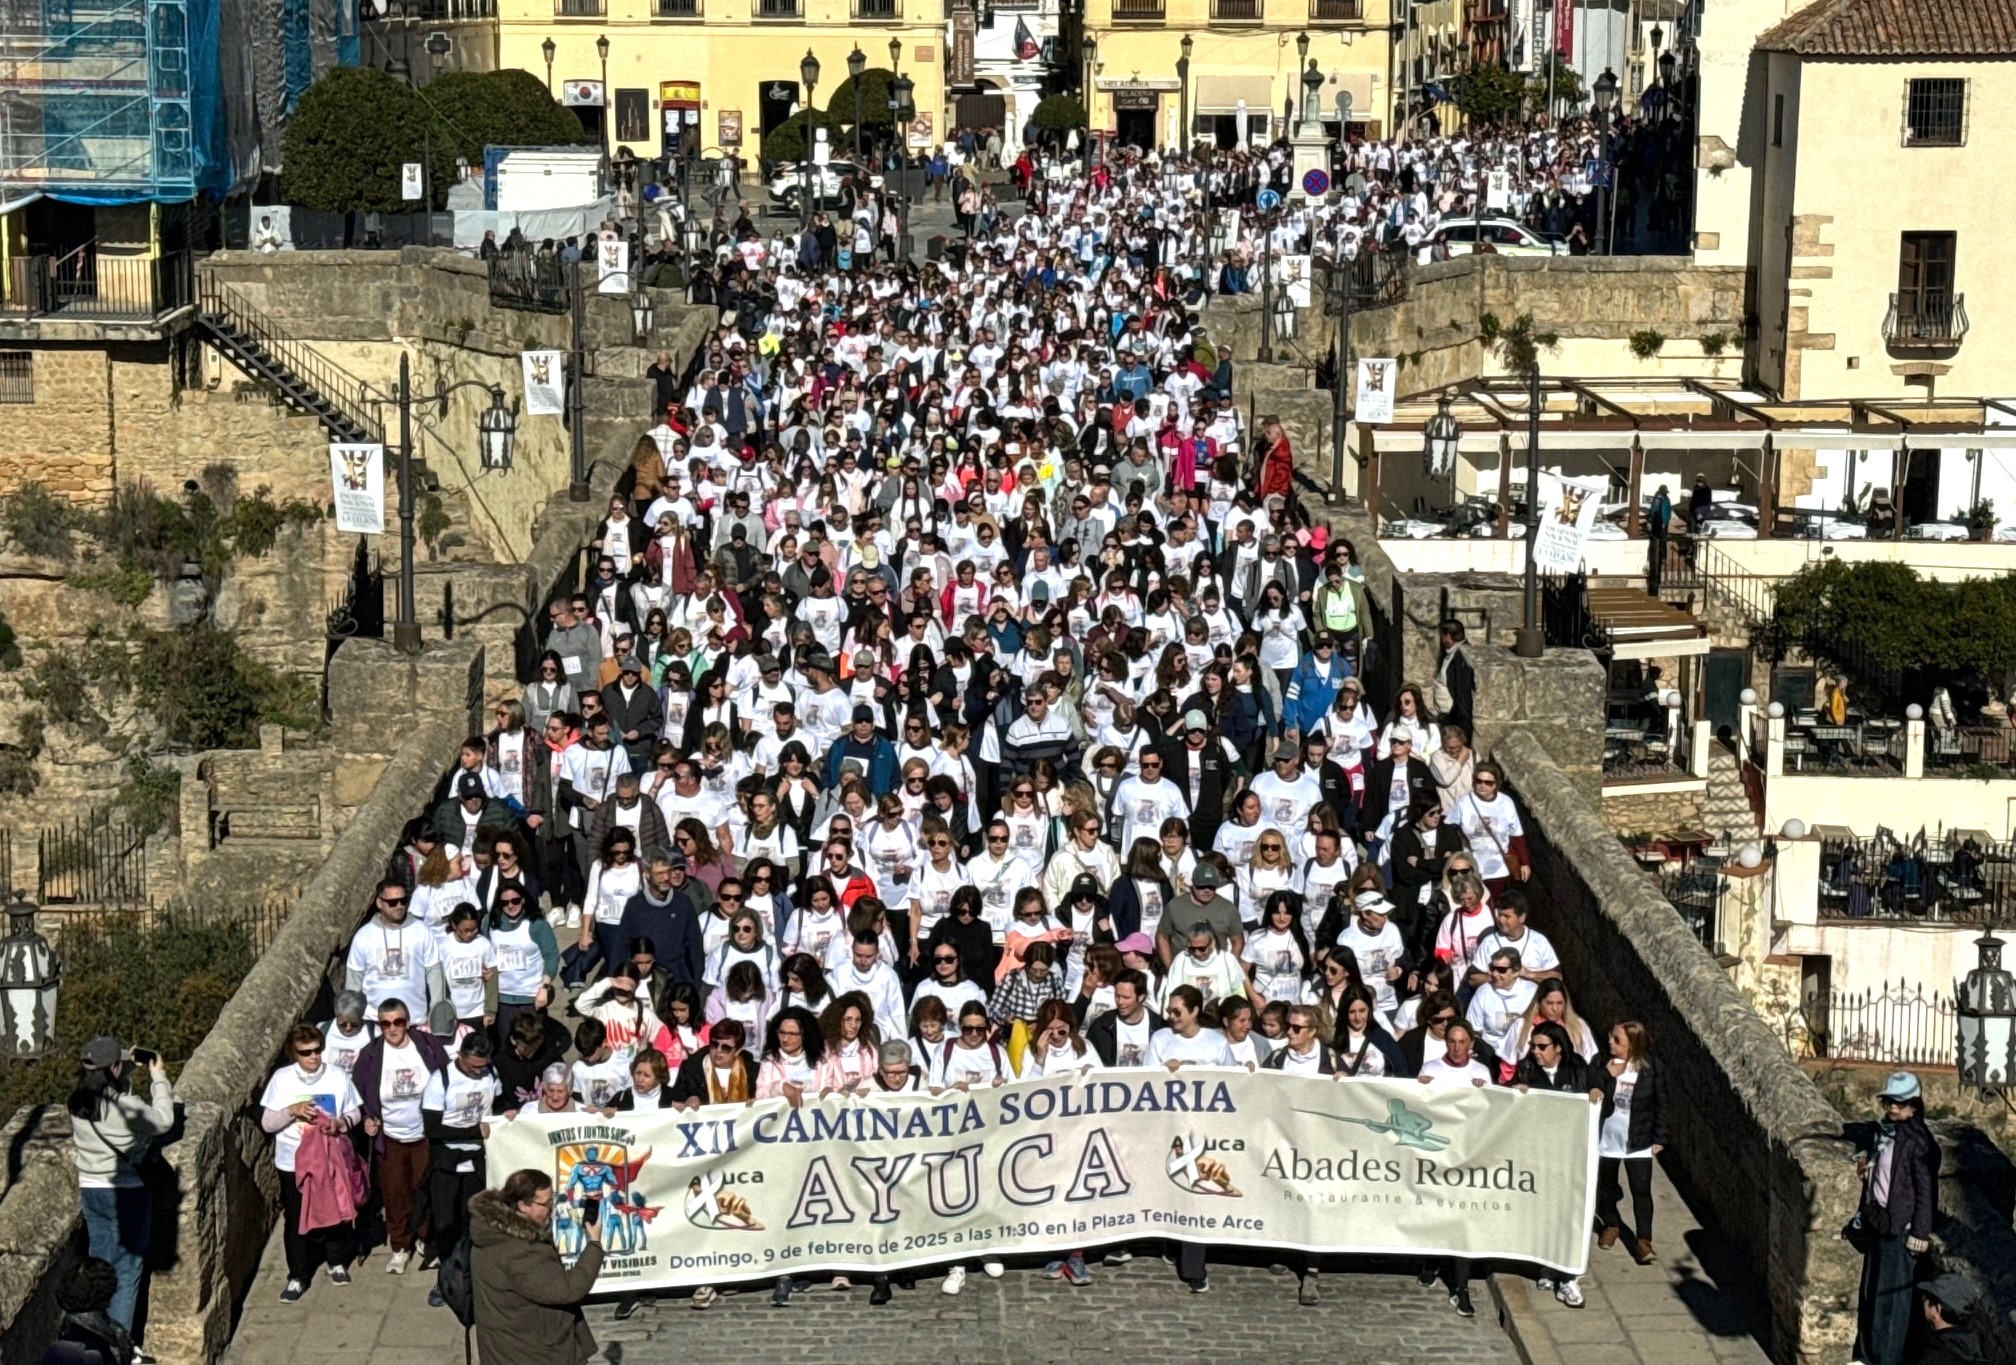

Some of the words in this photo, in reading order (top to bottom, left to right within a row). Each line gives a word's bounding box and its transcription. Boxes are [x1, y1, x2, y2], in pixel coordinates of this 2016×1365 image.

[577, 1126, 583, 1140] Y
[584, 1125, 610, 1140] JUNTAS
[676, 1119, 738, 1158] XII
[752, 1099, 985, 1143] CAMINATA
[999, 1080, 1237, 1126] SOLIDARIA
[786, 1127, 1132, 1230] AYUCA
[1260, 1147, 1401, 1183] Abades
[1414, 1158, 1538, 1194] Ronda
[1283, 1190, 1402, 1204] Restaurante
[1436, 1198, 1512, 1212] eventos
[670, 1250, 758, 1269] Domingo,
[764, 1248, 774, 1263] 9
[780, 1244, 802, 1260] de
[808, 1240, 874, 1256] febrero
[879, 1238, 899, 1254] de
[903, 1231, 948, 1251] 2025
[953, 1233, 963, 1244] a
[968, 1226, 993, 1242] las
[998, 1221, 1040, 1238] 11:30
[1046, 1221, 1067, 1235] en
[1072, 1218, 1087, 1233] la
[1092, 1211, 1136, 1230] Plaza
[1141, 1208, 1217, 1229] Teniente
[1222, 1214, 1264, 1231] Arce
[610, 1255, 657, 1270] VISIBLES
